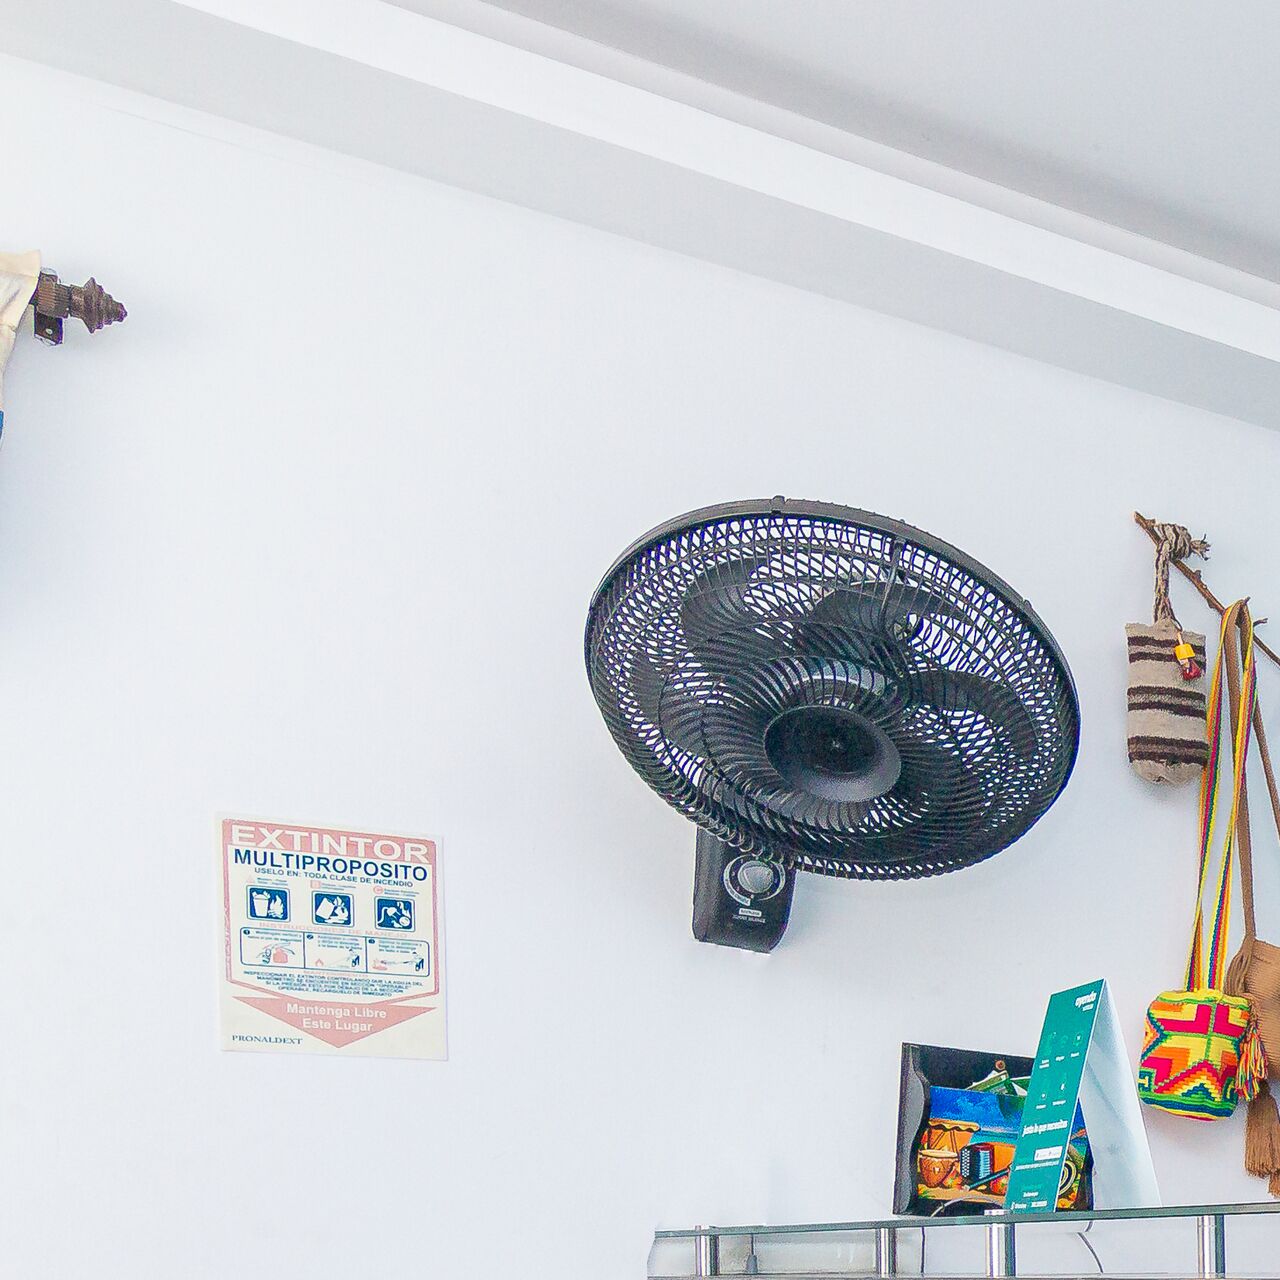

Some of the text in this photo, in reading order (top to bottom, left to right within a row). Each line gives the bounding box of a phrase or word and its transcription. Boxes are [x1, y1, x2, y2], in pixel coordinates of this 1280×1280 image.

[231, 824, 429, 863] EXTINTOR
[234, 848, 428, 882] MULTIPROPOSITO
[254, 867, 285, 876] USELO
[287, 870, 302, 878] EN:
[304, 872, 328, 881] TODA
[329, 875, 357, 883] CLASE
[374, 878, 414, 888] INCENDIO
[287, 1003, 387, 1019] Mantenga Libre
[302, 1018, 373, 1032] Este Lugar
